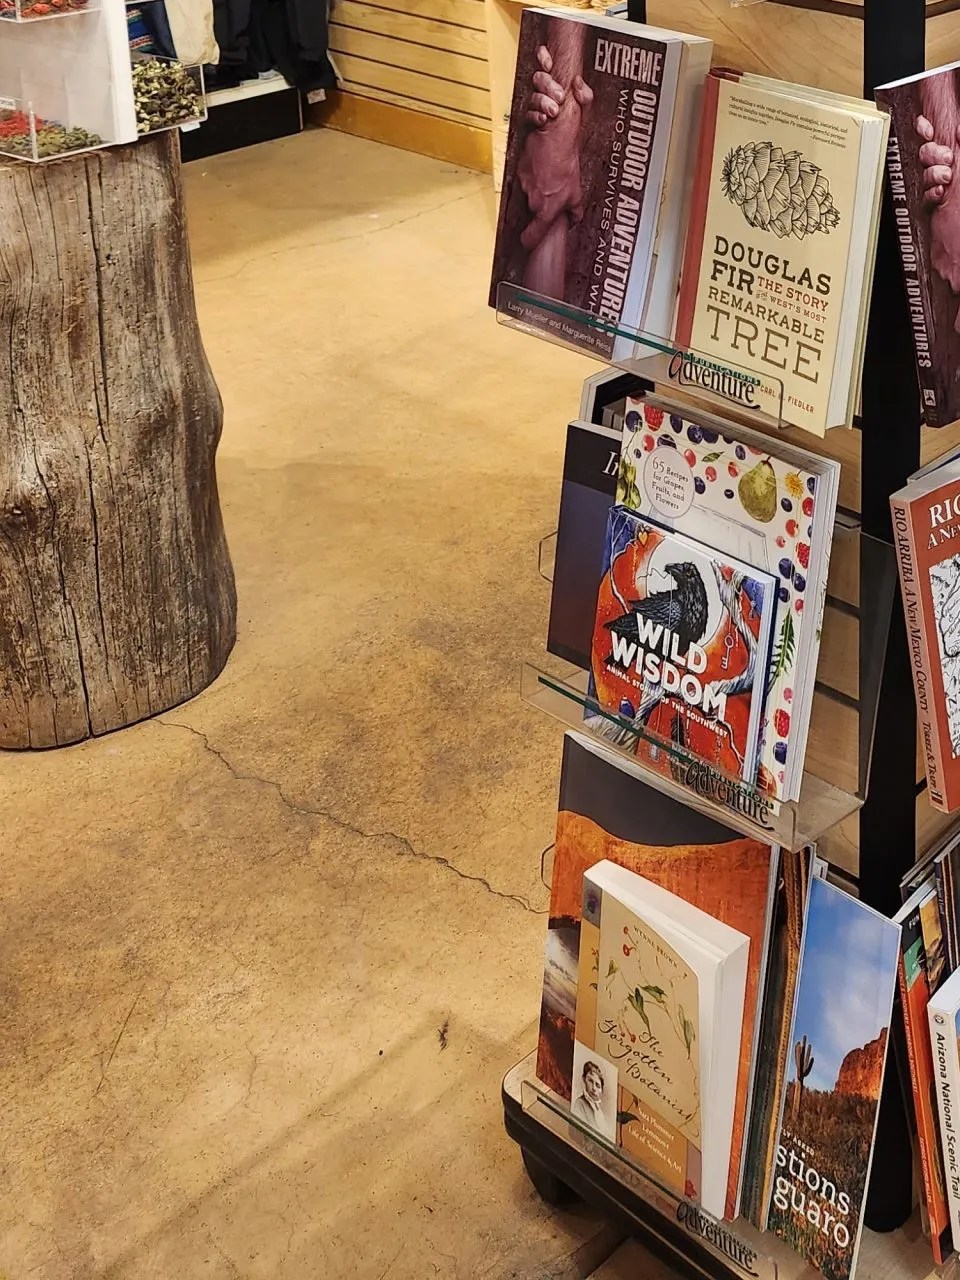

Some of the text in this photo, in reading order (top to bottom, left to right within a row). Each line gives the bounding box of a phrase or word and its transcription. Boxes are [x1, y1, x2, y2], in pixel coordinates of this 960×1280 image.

[594, 38, 664, 87] EXTREME
[621, 87, 657, 192] OUTDOOR
[592, 88, 629, 276] WHO SURVIVES AND
[713, 235, 832, 296] DOUGLAS
[887, 136, 932, 369] EXTREME OUTDOOR ADVENTURES
[710, 259, 830, 312] FIR THE STORY
[769, 295, 827, 324] WEST'S MOST
[507, 301, 595, 345] Larry Mueller and Marguerite
[708, 286, 826, 345] REMARKABLE
[706, 304, 823, 385] TREE
[760, 384, 815, 414] CARL FIEDLER
[651, 481, 685, 502] Fruits, and
[652, 456, 689, 483] 65 Recipes
[653, 471, 662, 482] for
[655, 493, 680, 510] Flowers
[893, 506, 914, 600] RIO ARRIBA A
[927, 533, 938, 549] A
[636, 612, 707, 674] WILD
[606, 664, 728, 737] ANIMAL OF THE SOUTHWEST
[611, 630, 728, 722] WISDOM
[656, 946, 679, 970] BROWN
[598, 1019, 674, 1086] Forgotten
[638, 1030, 665, 1058] The
[935, 1031, 948, 1078] Arizona
[625, 1056, 694, 1122] Botanist
[942, 1081, 956, 1133] National
[627, 1124, 683, 1173] Life Science Art
[793, 1136, 816, 1157] ASKED
[947, 1133, 959, 1174] Scenic
[775, 1145, 851, 1216] stions
[773, 1175, 850, 1249] guaro
